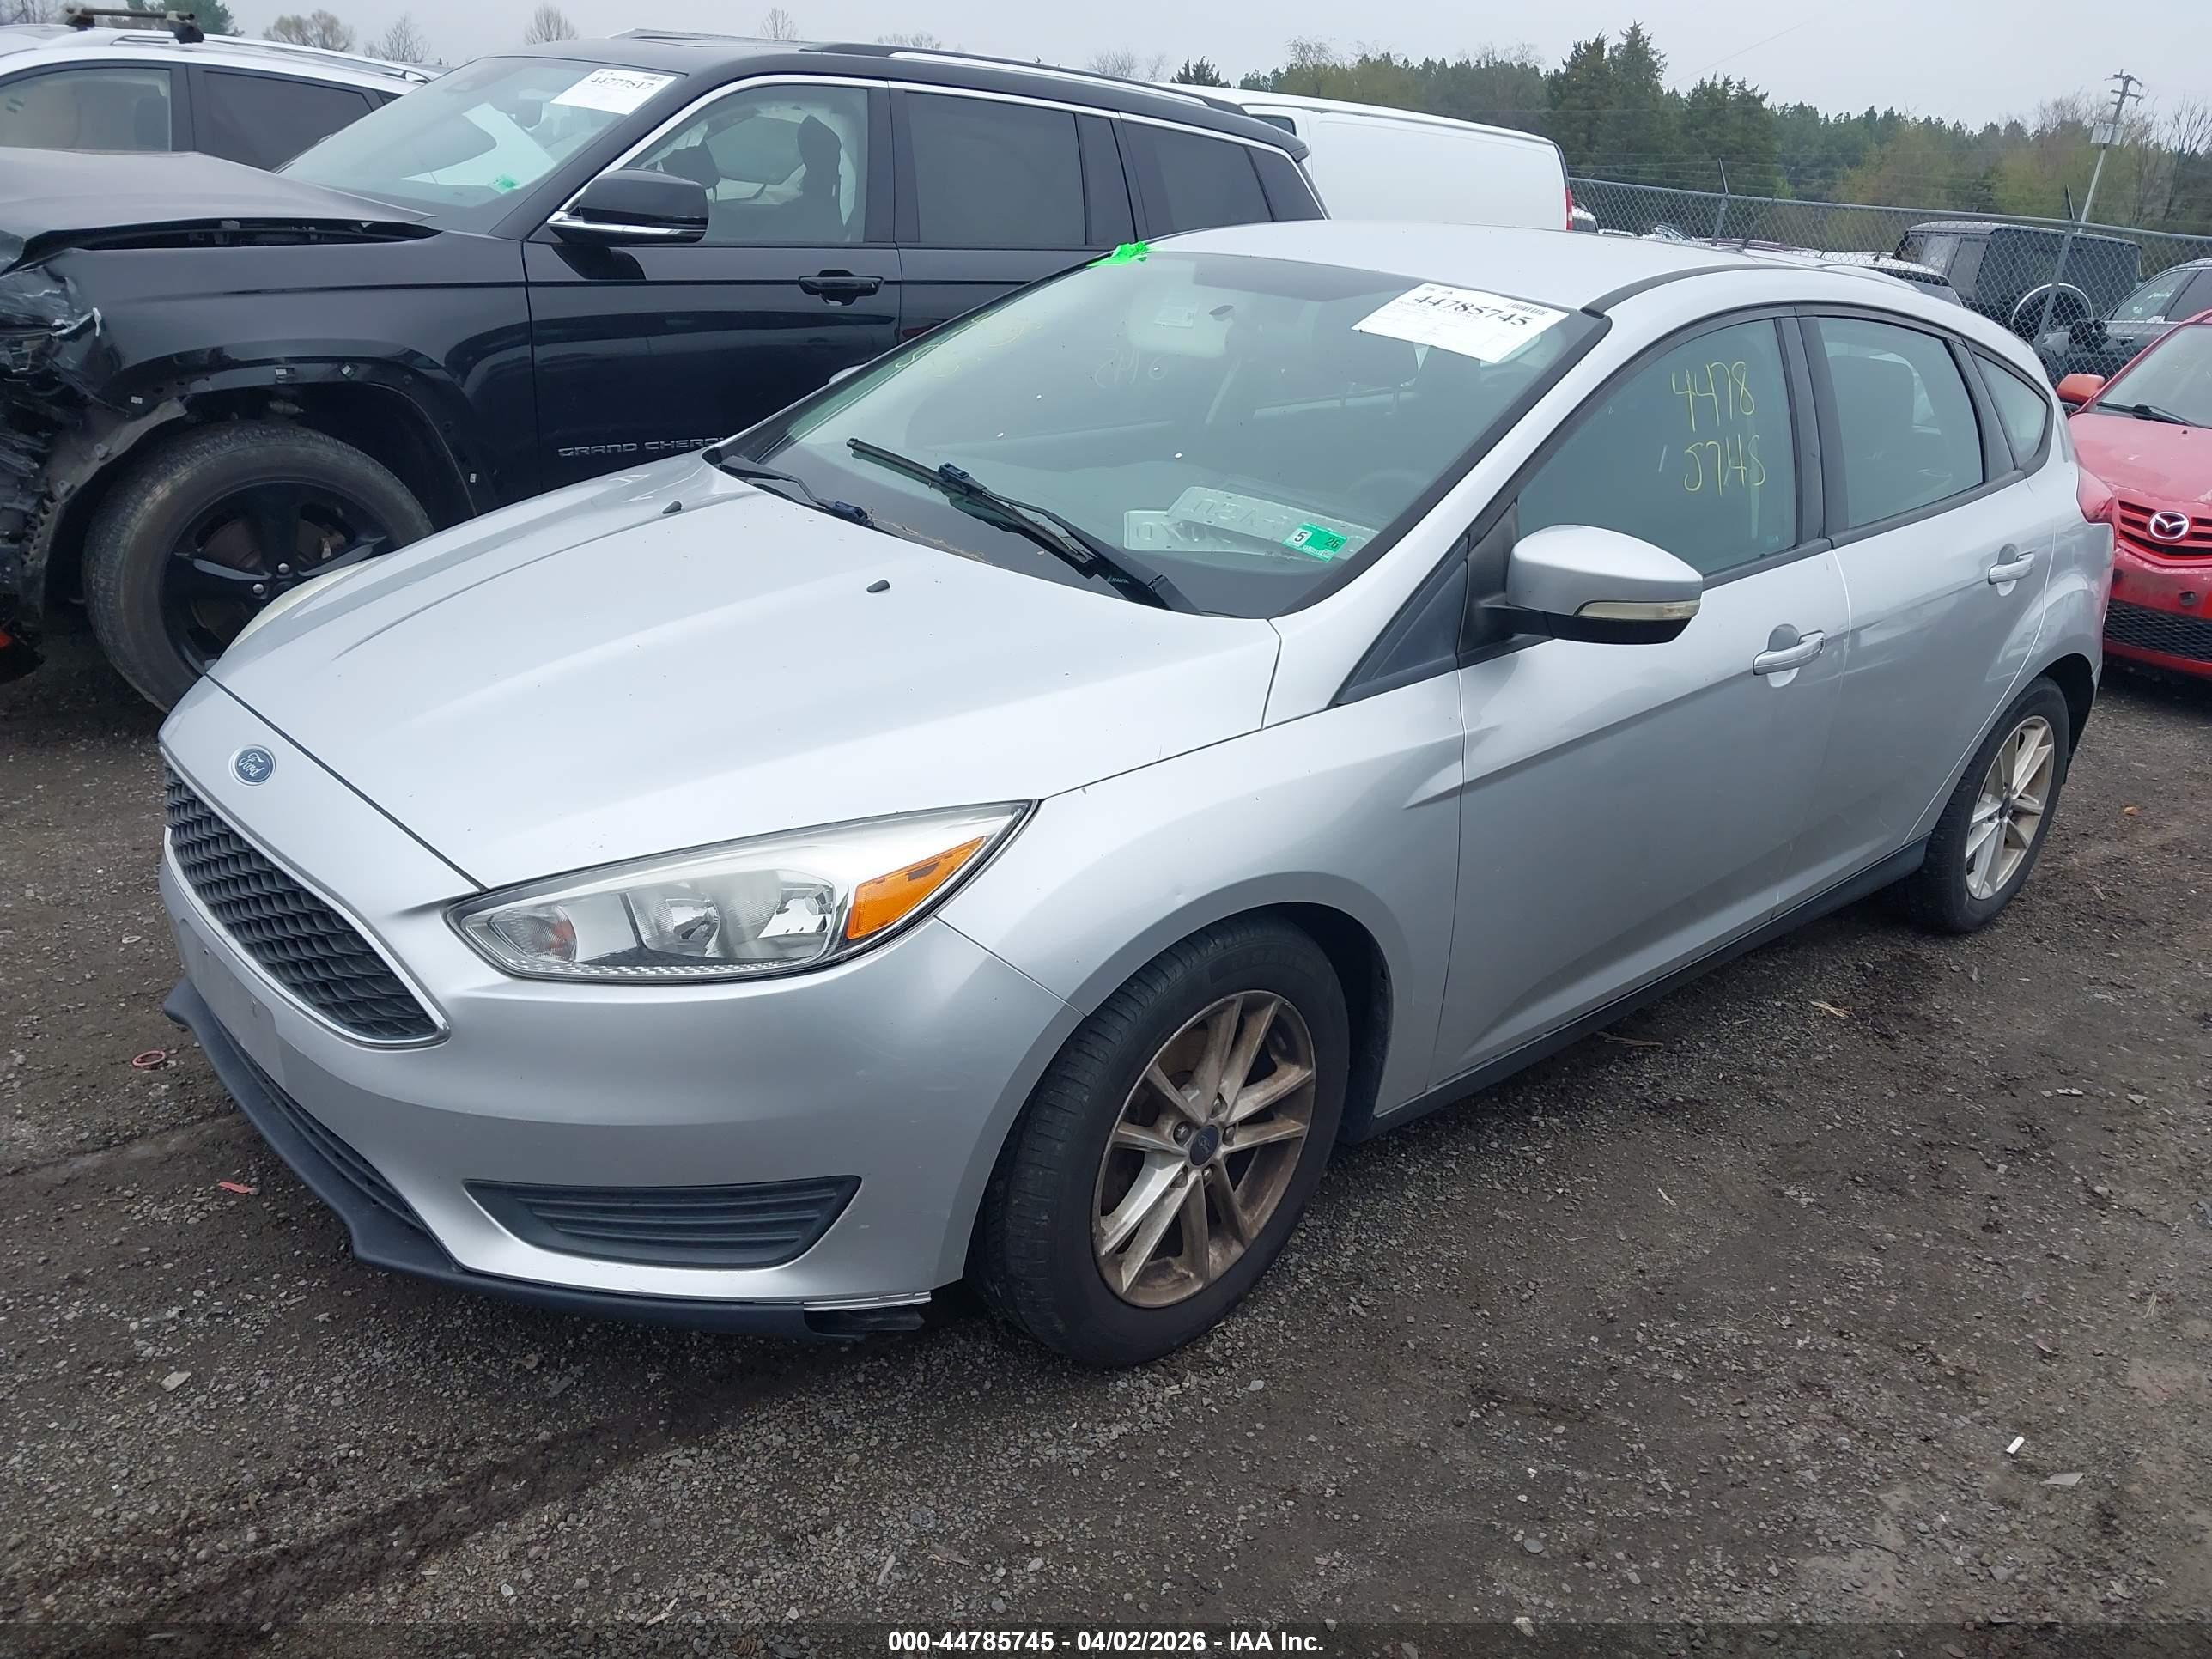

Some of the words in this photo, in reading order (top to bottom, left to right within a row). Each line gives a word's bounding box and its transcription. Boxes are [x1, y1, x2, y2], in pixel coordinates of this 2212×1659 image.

[1413, 295, 1534, 325] 44785745
[1671, 360, 1755, 433] 4478
[557, 442, 638, 457] GRAND
[644, 436, 724, 450] CHERO
[1683, 432, 1766, 496] 5745
[1294, 531, 1309, 543] 5
[1324, 537, 1342, 549] 26
